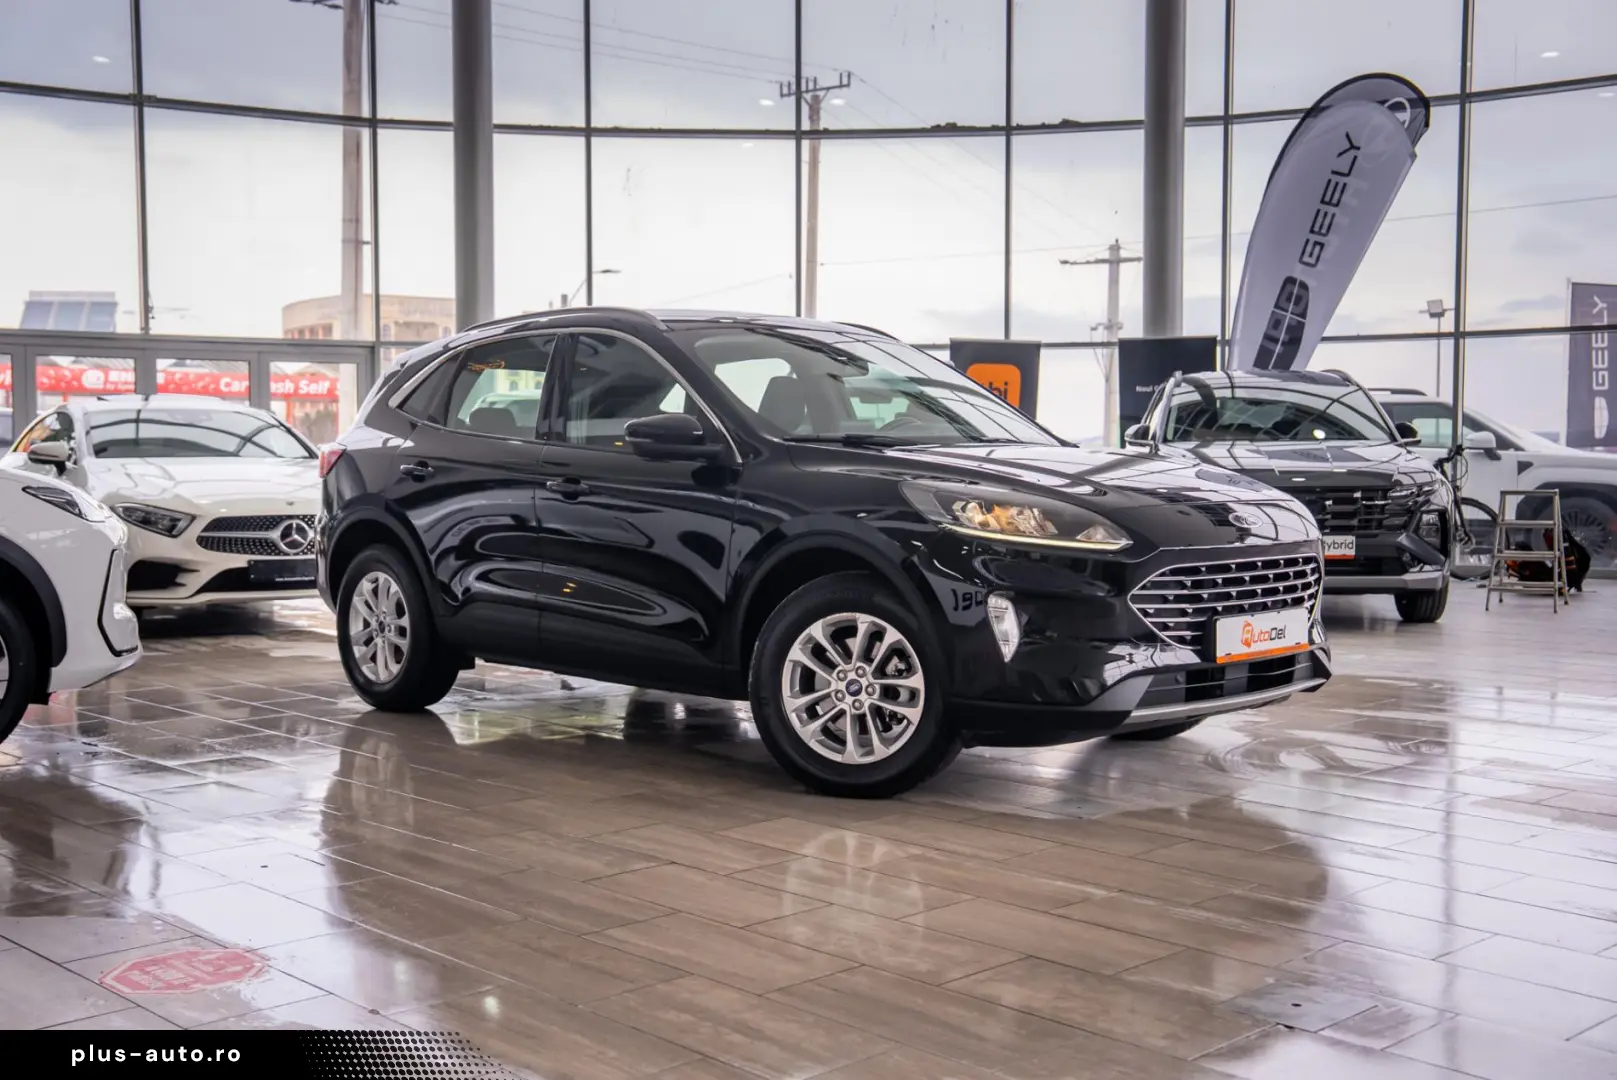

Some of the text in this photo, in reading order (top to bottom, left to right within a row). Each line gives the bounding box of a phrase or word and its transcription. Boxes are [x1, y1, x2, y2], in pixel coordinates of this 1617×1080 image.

[1298, 131, 1361, 268] GEELY
[1592, 294, 1609, 391] GEELY
[219, 377, 249, 393] Car
[298, 379, 330, 395] Self
[1322, 539, 1354, 550] ybrid
[1241, 620, 1287, 649] AutoDel
